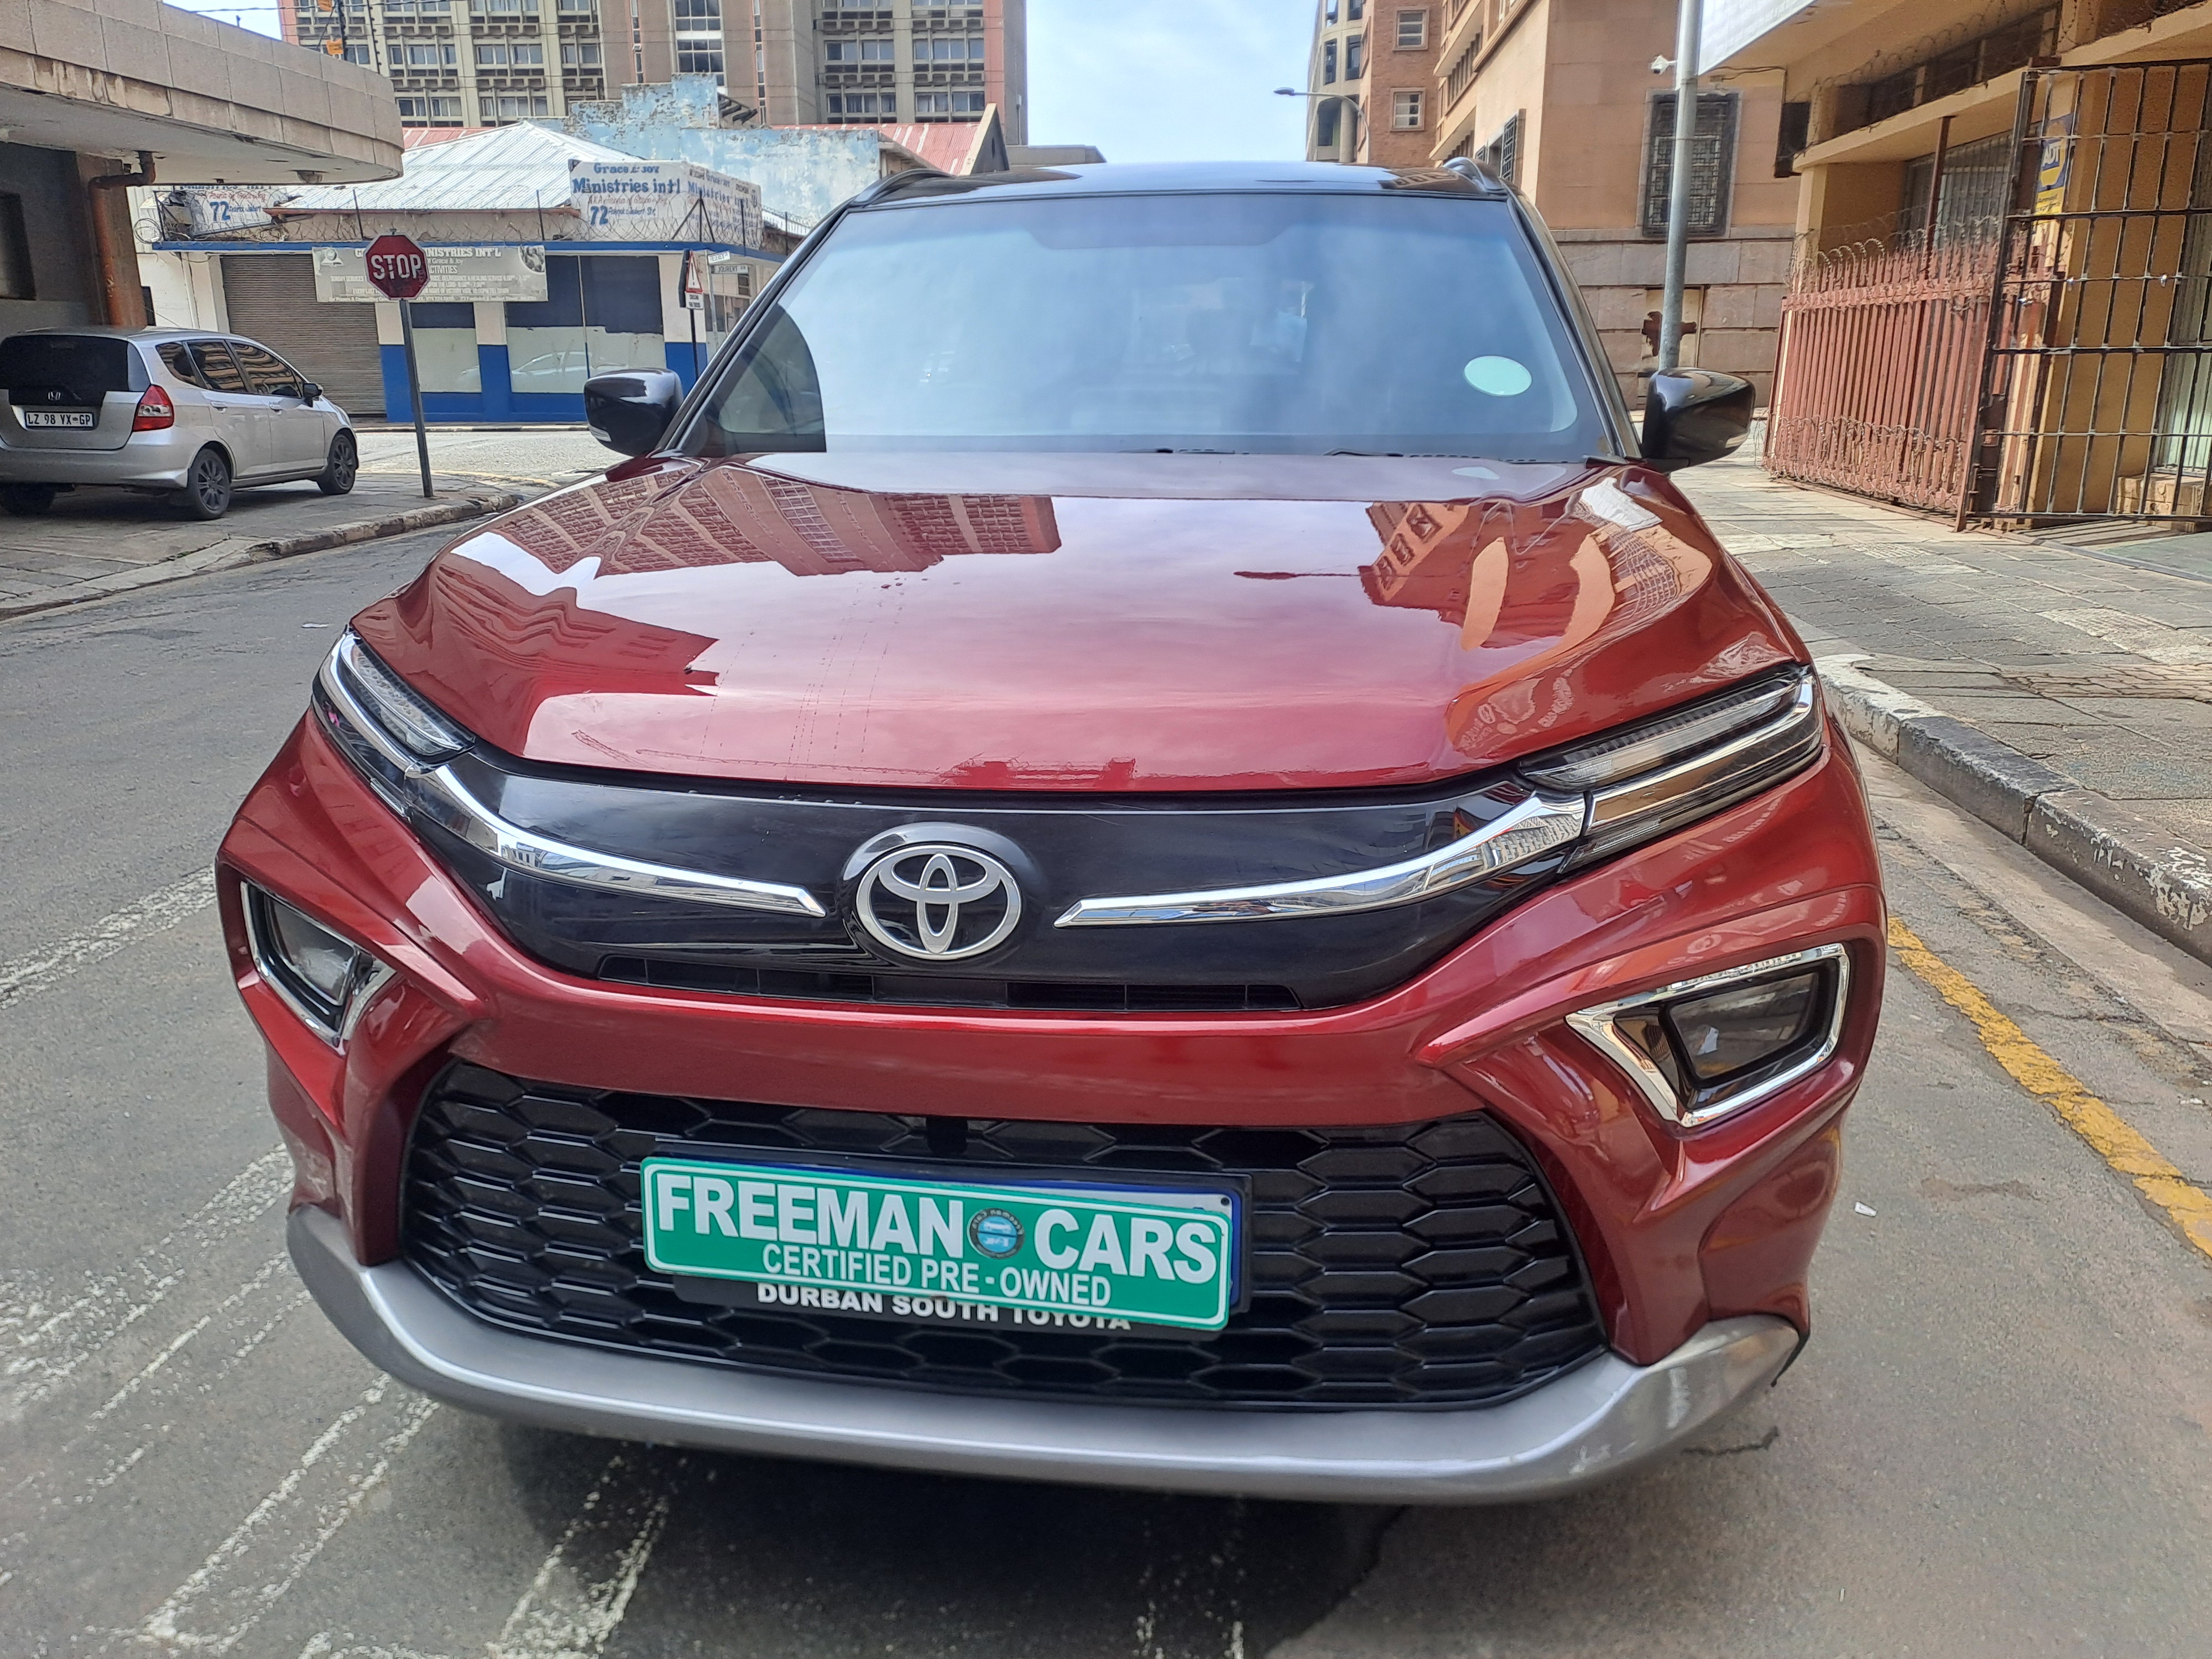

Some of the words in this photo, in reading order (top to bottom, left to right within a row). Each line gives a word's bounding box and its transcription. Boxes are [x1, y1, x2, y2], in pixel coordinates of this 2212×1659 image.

[2042, 144, 2060, 166] ADT
[593, 163, 629, 174] Grace
[572, 178, 649, 194] Ministries
[210, 201, 231, 222] 72
[590, 205, 608, 226] 72
[424, 247, 473, 257] INISTRIES
[371, 254, 422, 280] STOP
[28, 414, 39, 424] LZ
[44, 414, 55, 424] 98
[656, 1173, 964, 1259] FREEMAN
[1034, 1208, 1217, 1284] CARS
[763, 1243, 912, 1286] CERTIFIED
[757, 1282, 883, 1314] DURBAN
[891, 1295, 999, 1323] SOUTH
